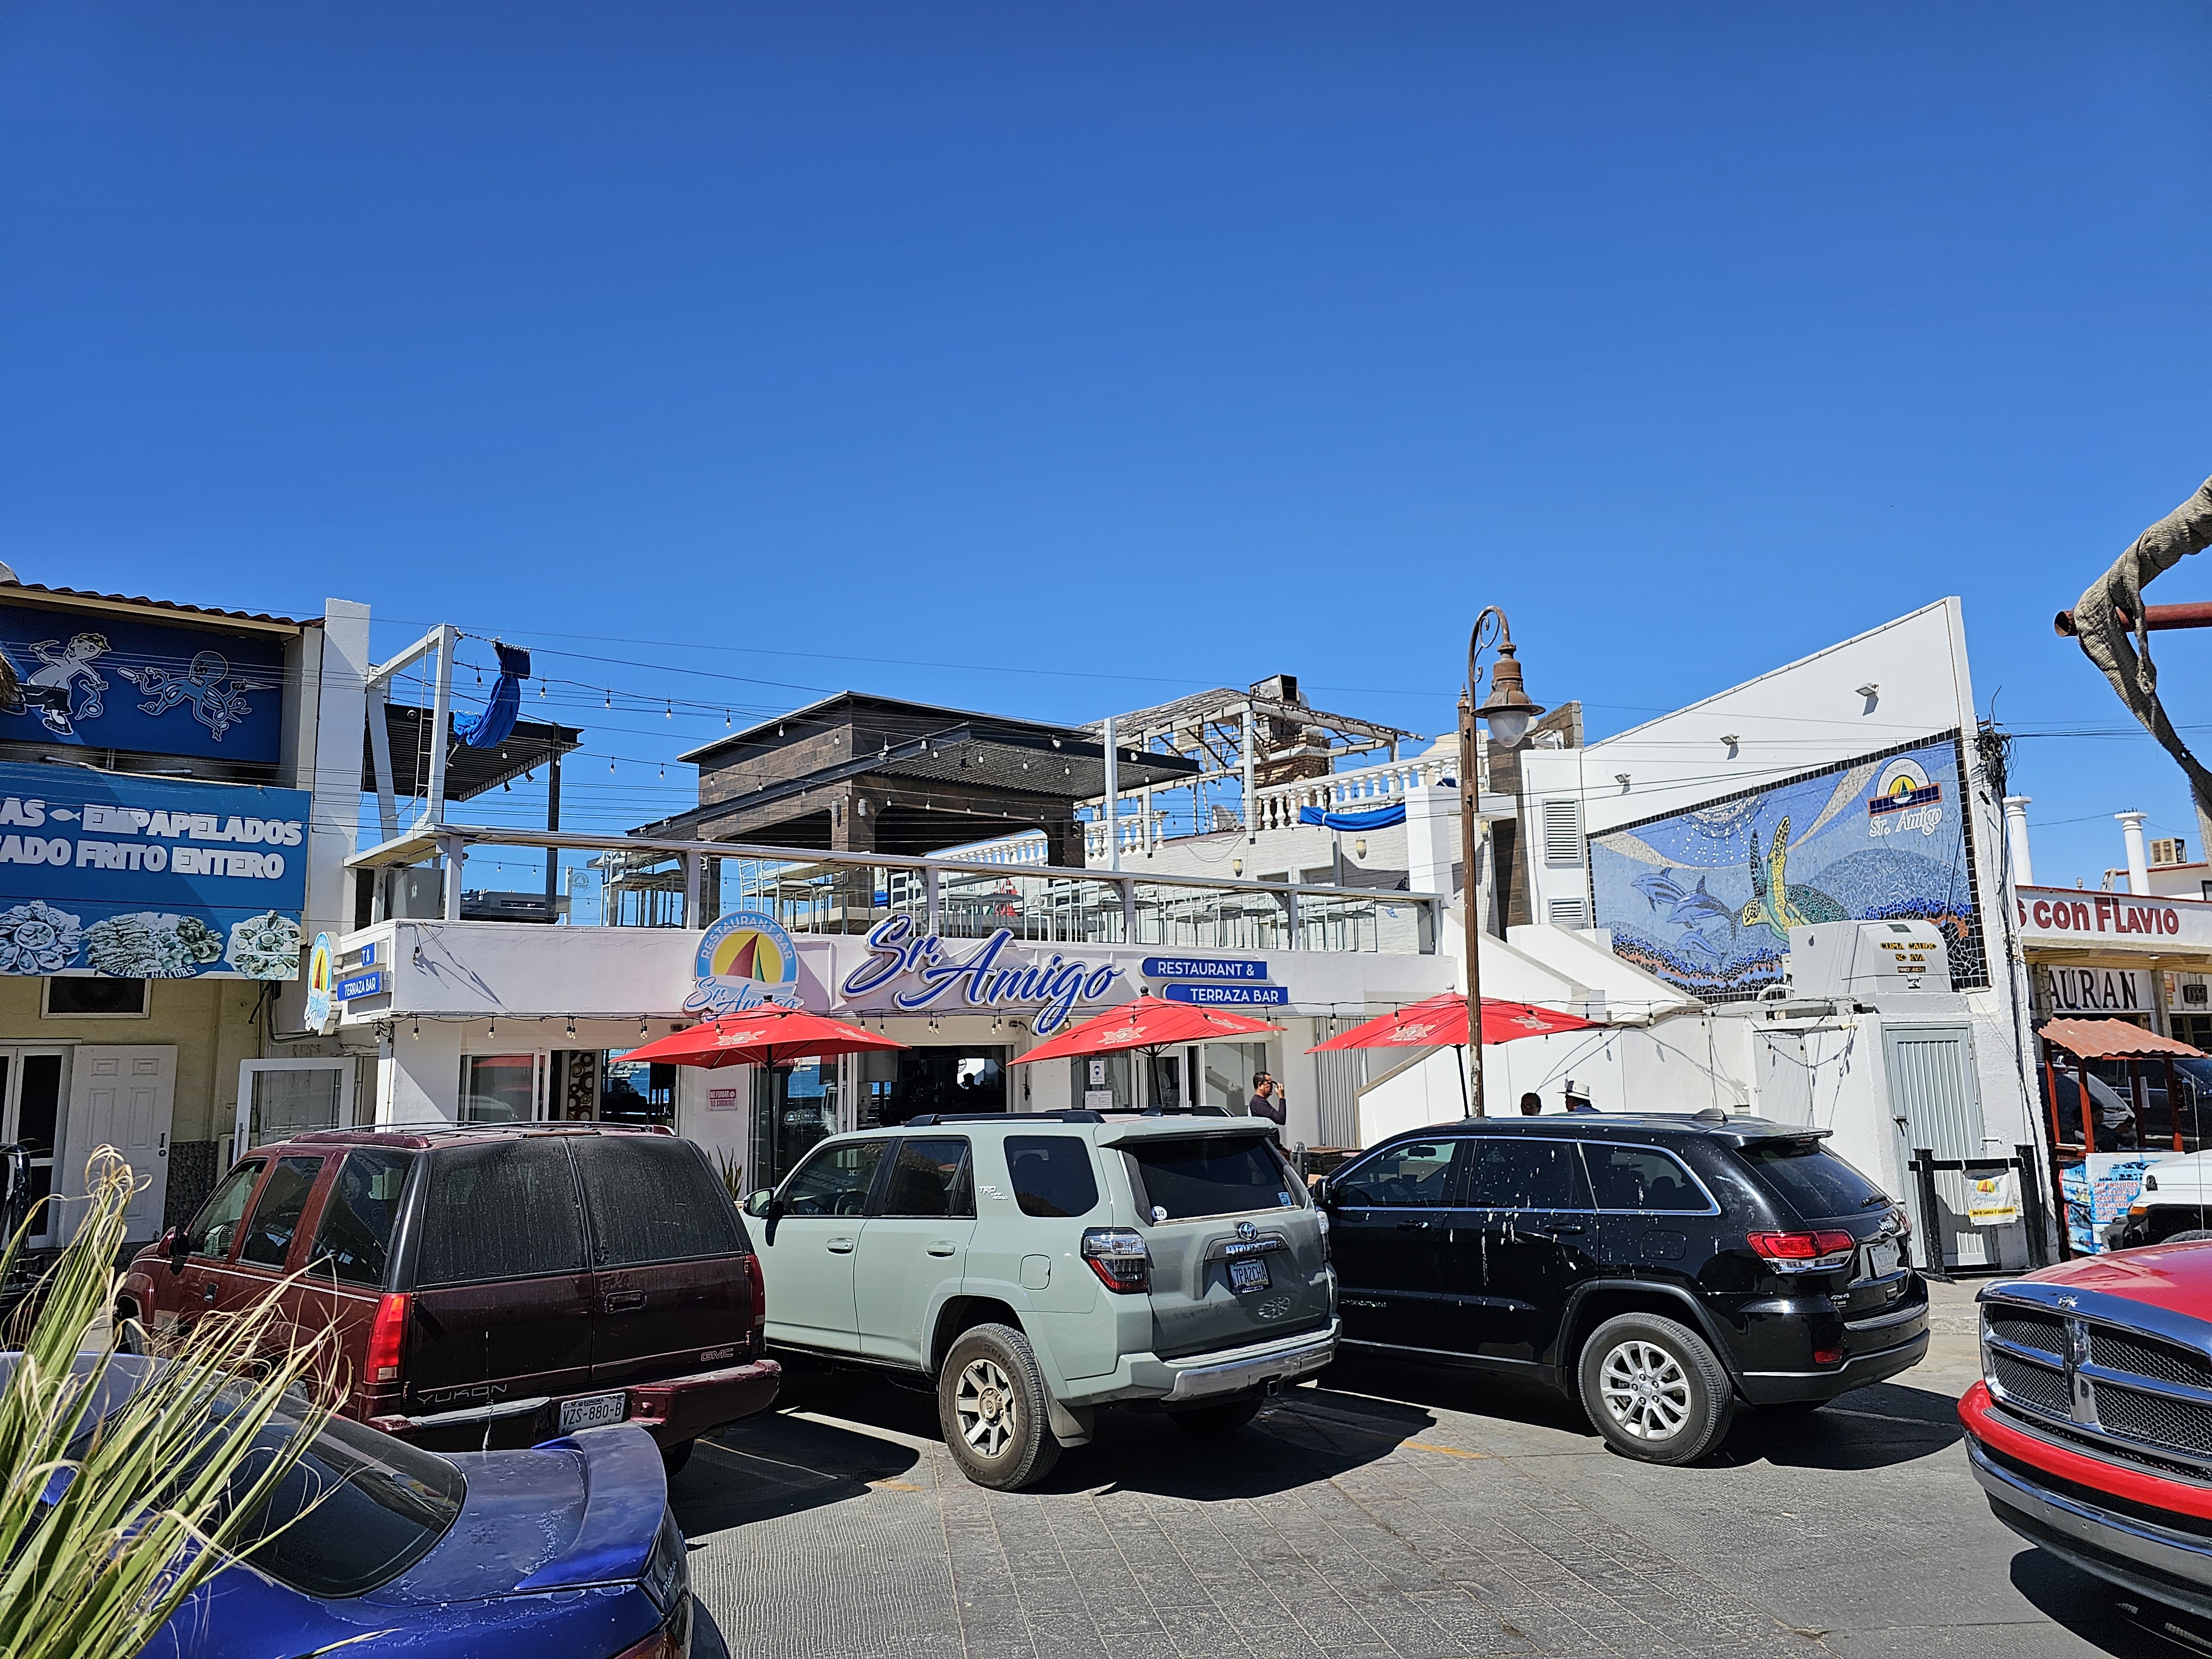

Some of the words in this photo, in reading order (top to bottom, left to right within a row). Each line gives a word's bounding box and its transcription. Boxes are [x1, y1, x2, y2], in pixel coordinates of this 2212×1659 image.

[0, 797, 45, 827] AS
[82, 804, 302, 846] EMPAPELADOS
[1869, 816, 1891, 837] Sr.
[1895, 805, 1943, 836] Amigo
[0, 834, 72, 866] ADO
[75, 839, 168, 872] FRITO
[171, 847, 285, 879] ENTERO
[701, 915, 776, 959] RESTAURANT
[775, 932, 793, 961] BAR
[1910, 953, 1926, 962] KVA
[151, 966, 197, 979] GATORS
[841, 913, 943, 995] Sr.
[895, 927, 1126, 1036] Amigo
[1157, 961, 1243, 977] RESTAURANT
[1245, 963, 1254, 977] &
[344, 979, 365, 997] TERRAZA
[366, 977, 376, 993] BAR
[686, 975, 726, 1008] Sr.
[1190, 988, 1250, 1003] TERRAZA
[1254, 989, 1279, 1003] BAR
[978, 1186, 997, 1194] TRD
[701, 1348, 734, 1361] GMC
[416, 1383, 508, 1405] YUKON
[563, 1402, 622, 1426] VZS-880-B
